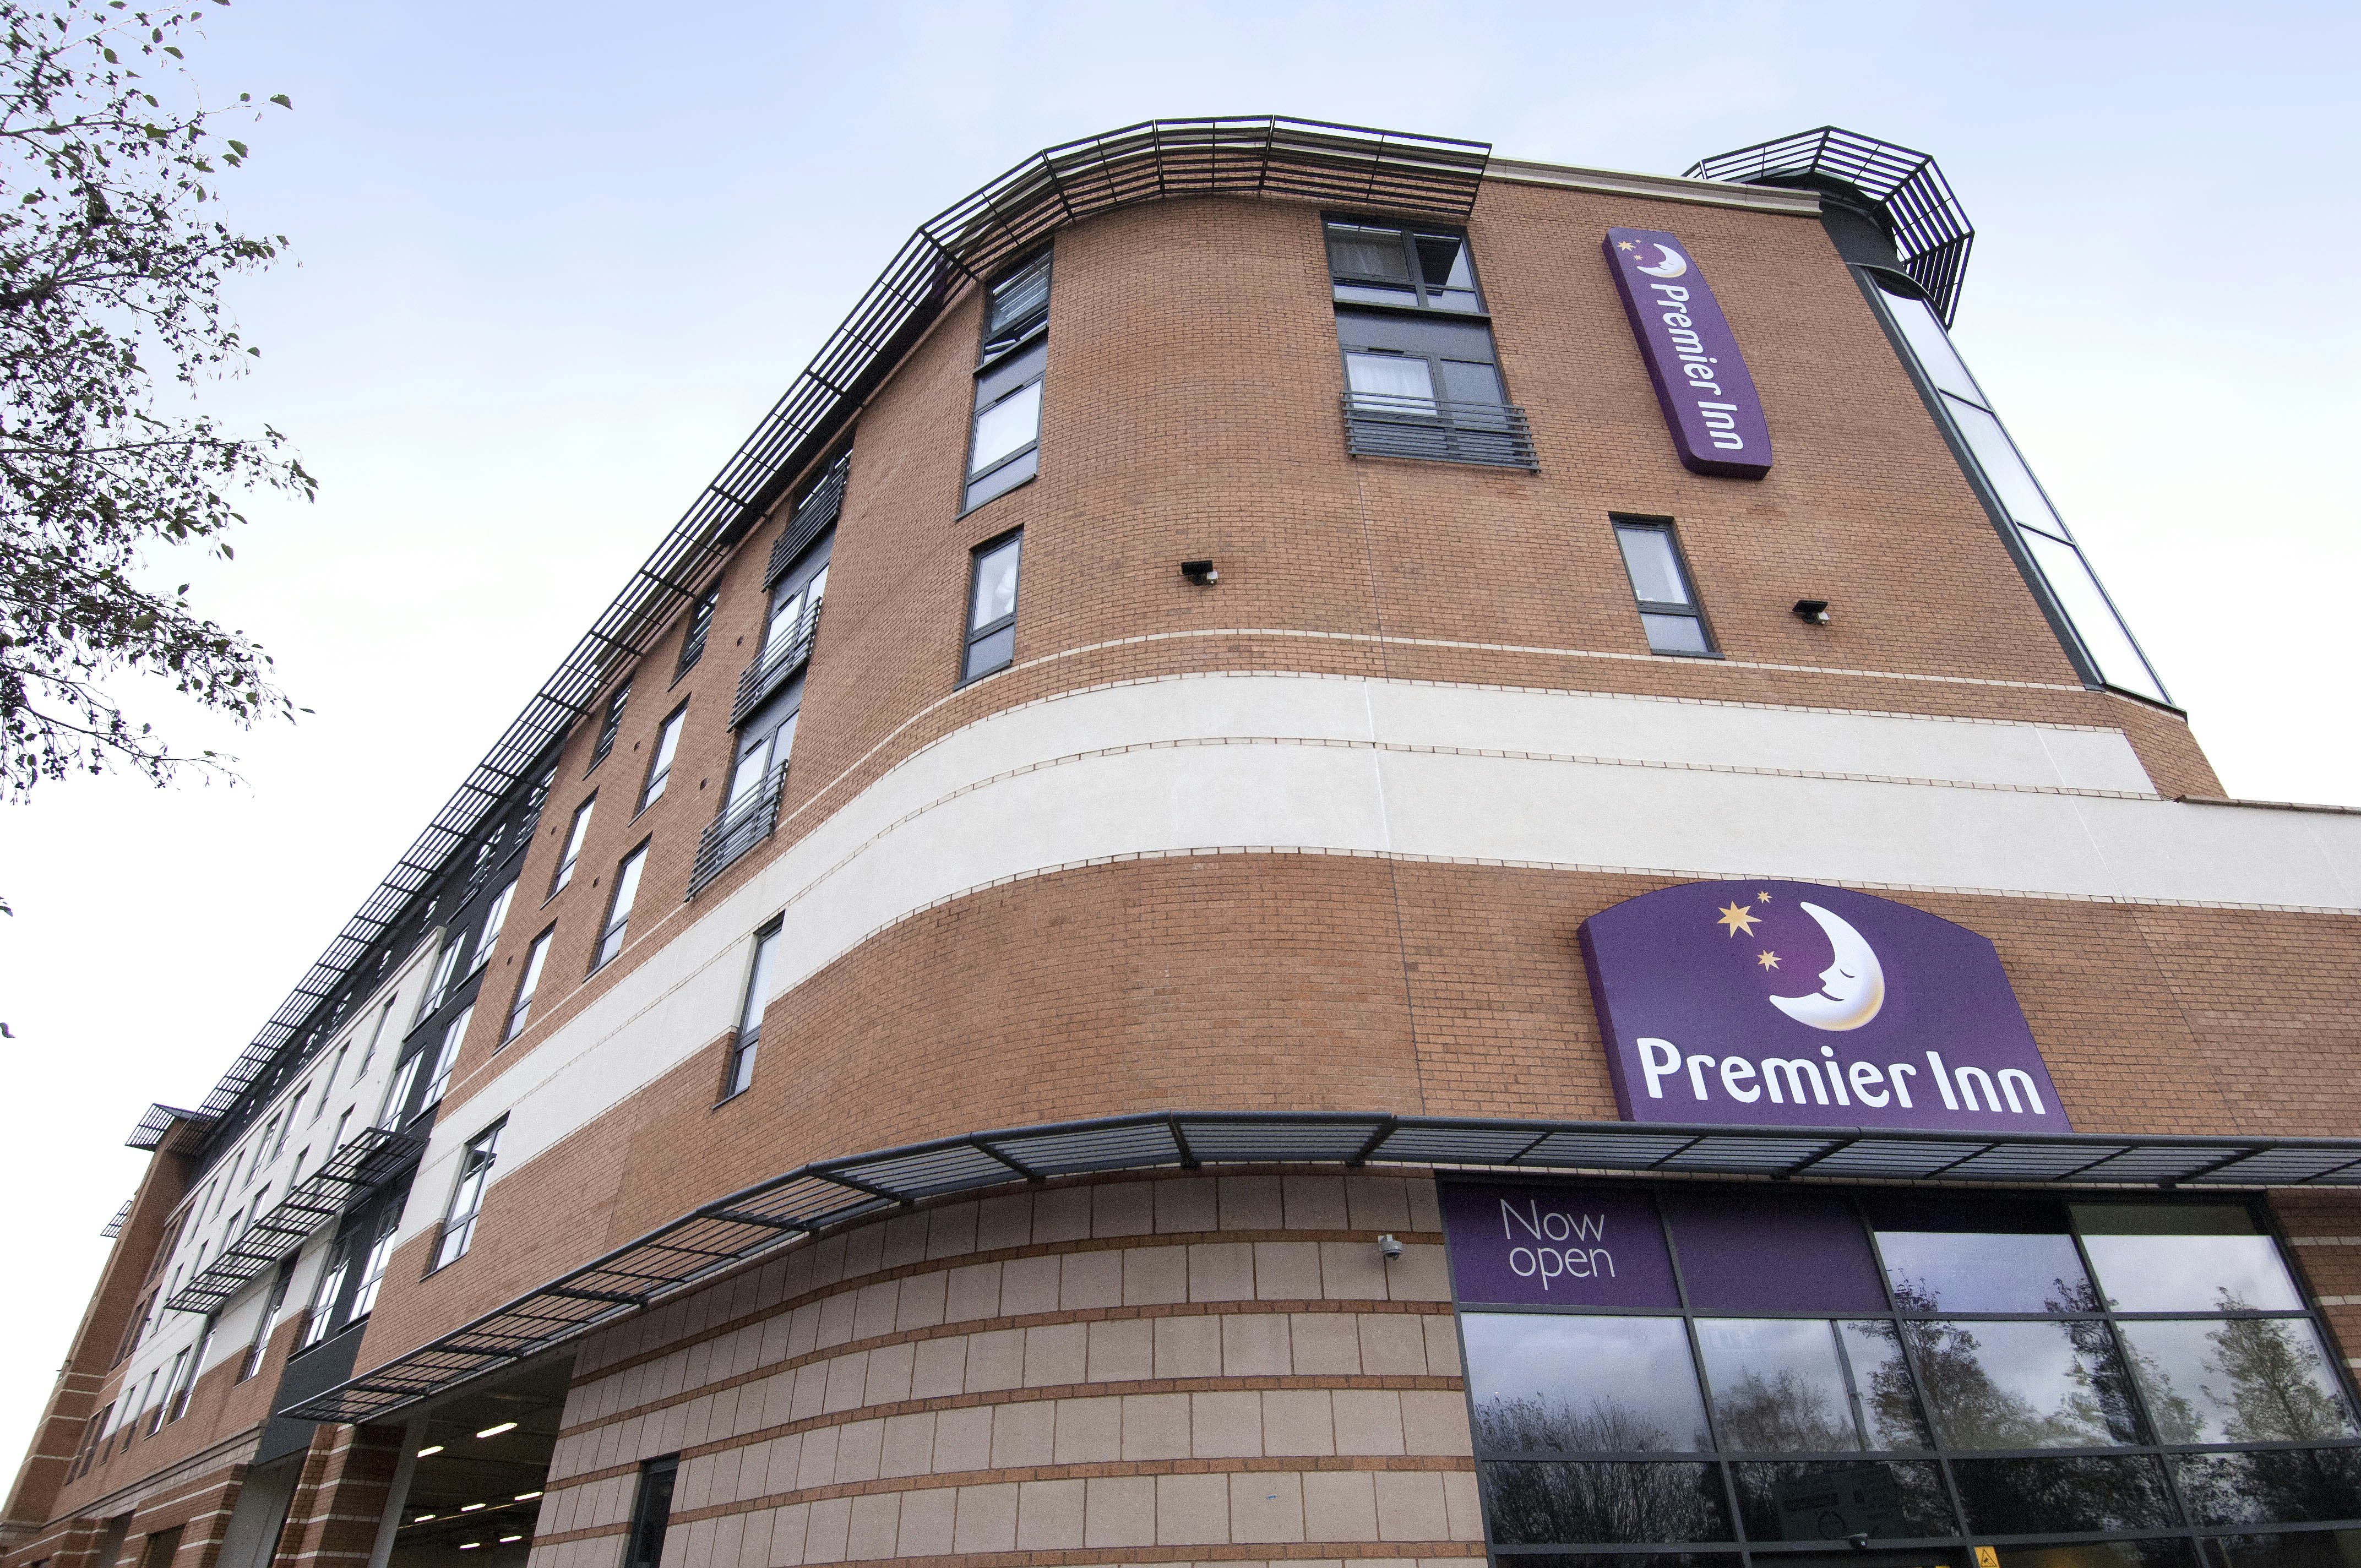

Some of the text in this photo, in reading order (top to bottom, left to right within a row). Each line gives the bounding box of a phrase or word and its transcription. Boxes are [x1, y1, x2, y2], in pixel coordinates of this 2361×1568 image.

[1650, 283, 1744, 450] Premier Inn
[1636, 1038, 2047, 1115] Premier Inn
[1500, 1199, 1604, 1242] Now
[1509, 1247, 1615, 1291] open
